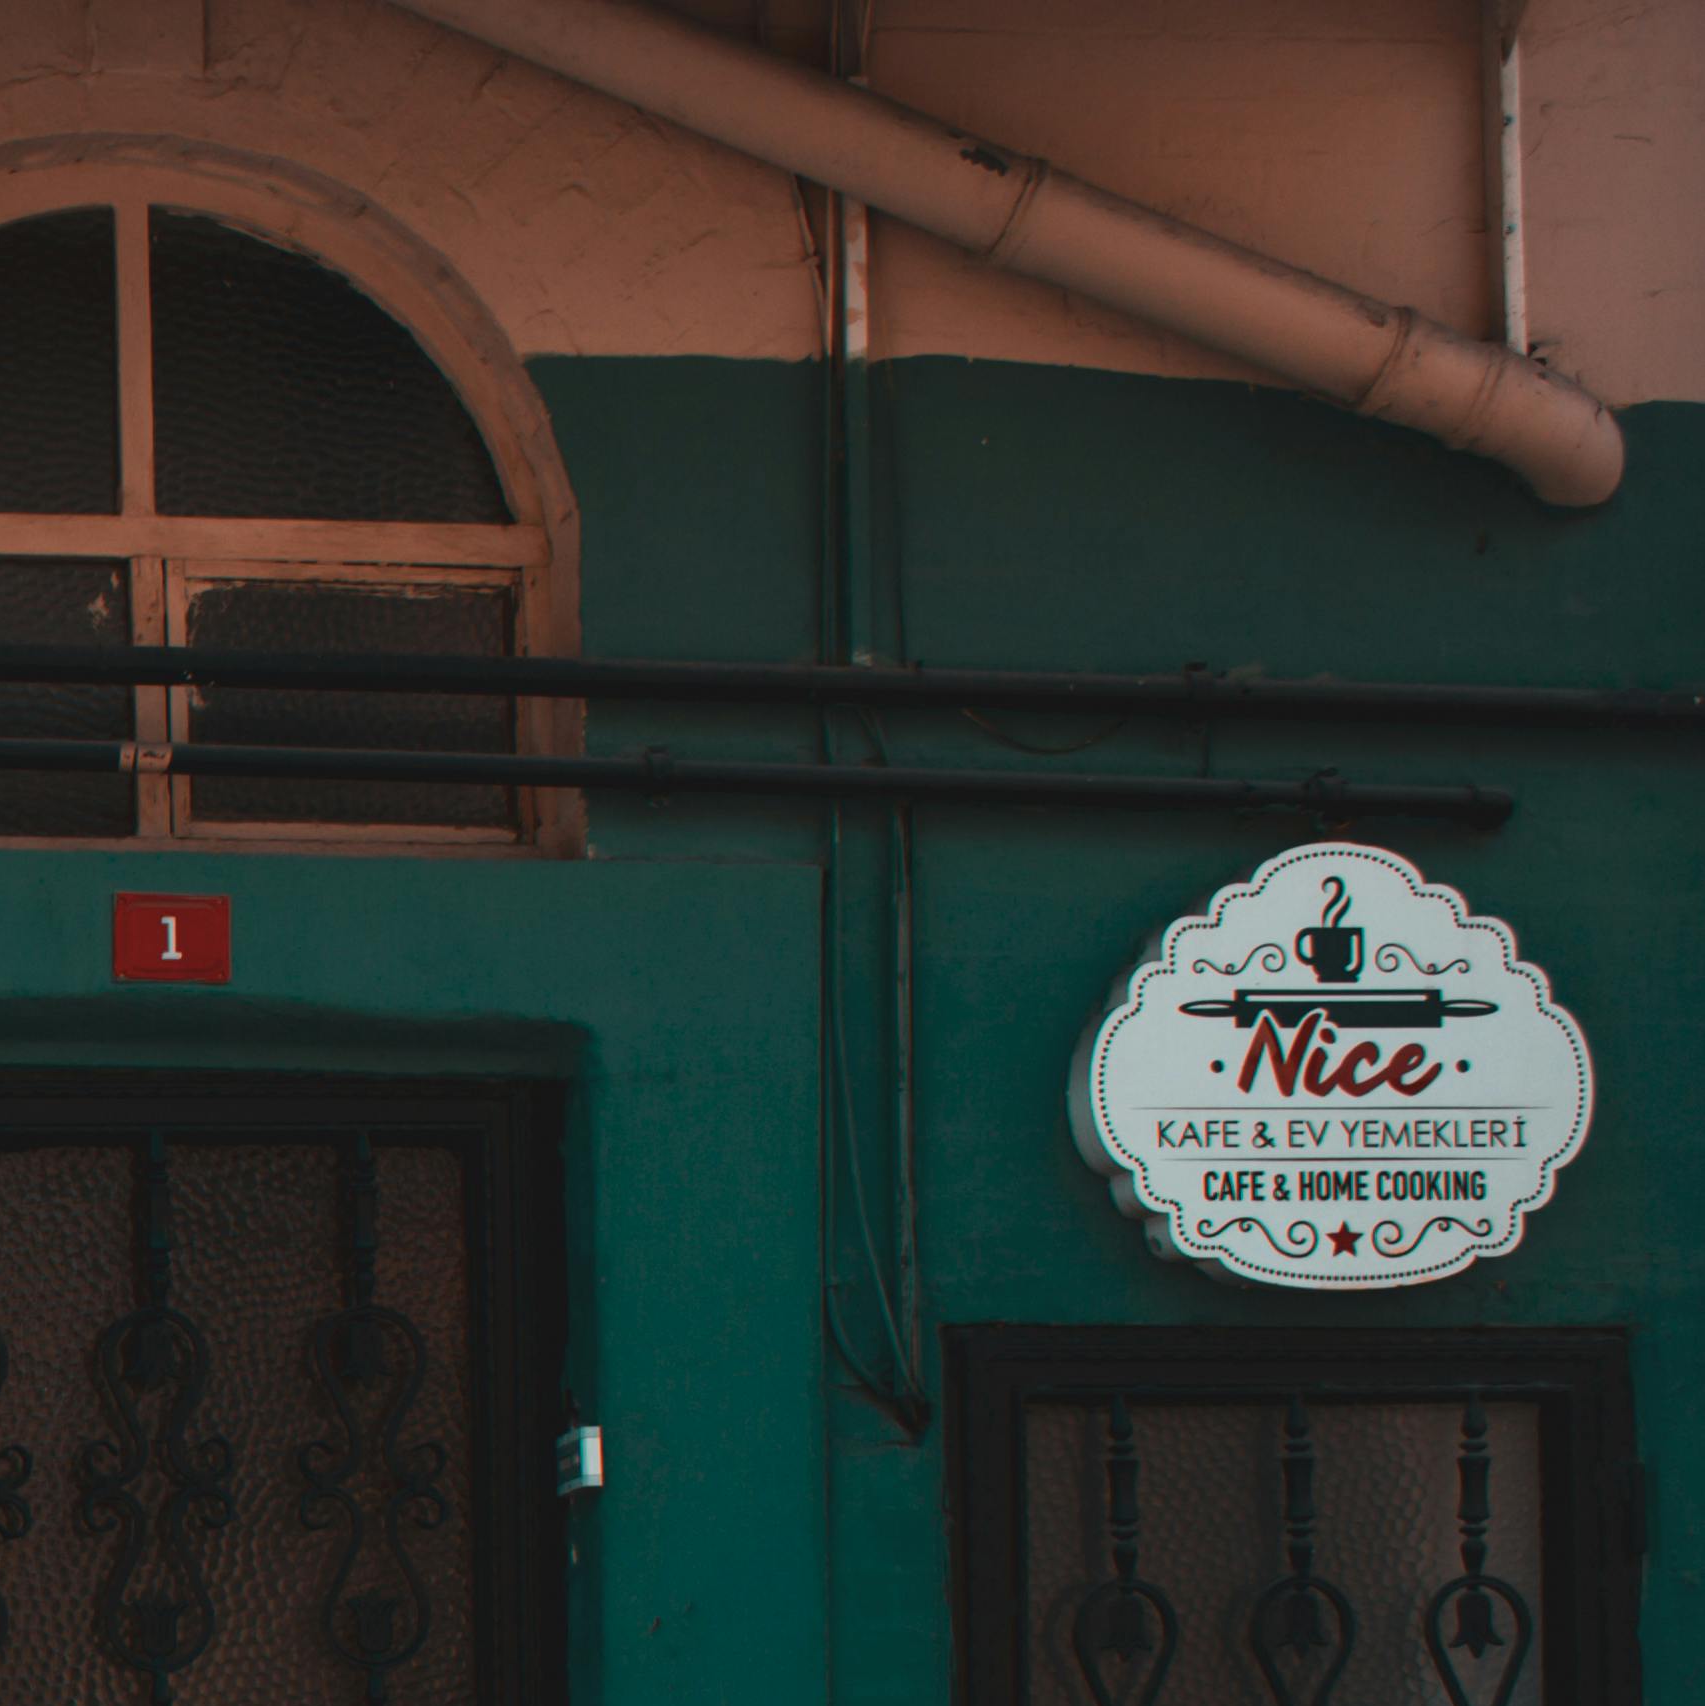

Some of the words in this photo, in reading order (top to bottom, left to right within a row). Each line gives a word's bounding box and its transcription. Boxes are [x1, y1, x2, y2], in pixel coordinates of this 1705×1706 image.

[161, 916, 182, 960] 1
[1236, 1008, 1442, 1098] Nice
[1155, 1119, 1240, 1149] KAFE
[1251, 1120, 1276, 1149] &
[1287, 1119, 1330, 1149] EV
[1339, 1115, 1529, 1149] YEMEKLERİ
[1202, 1170, 1266, 1202] CAFE
[1272, 1170, 1291, 1202] &
[1298, 1170, 1370, 1202] HOME
[1375, 1169, 1487, 1202] COOKING
